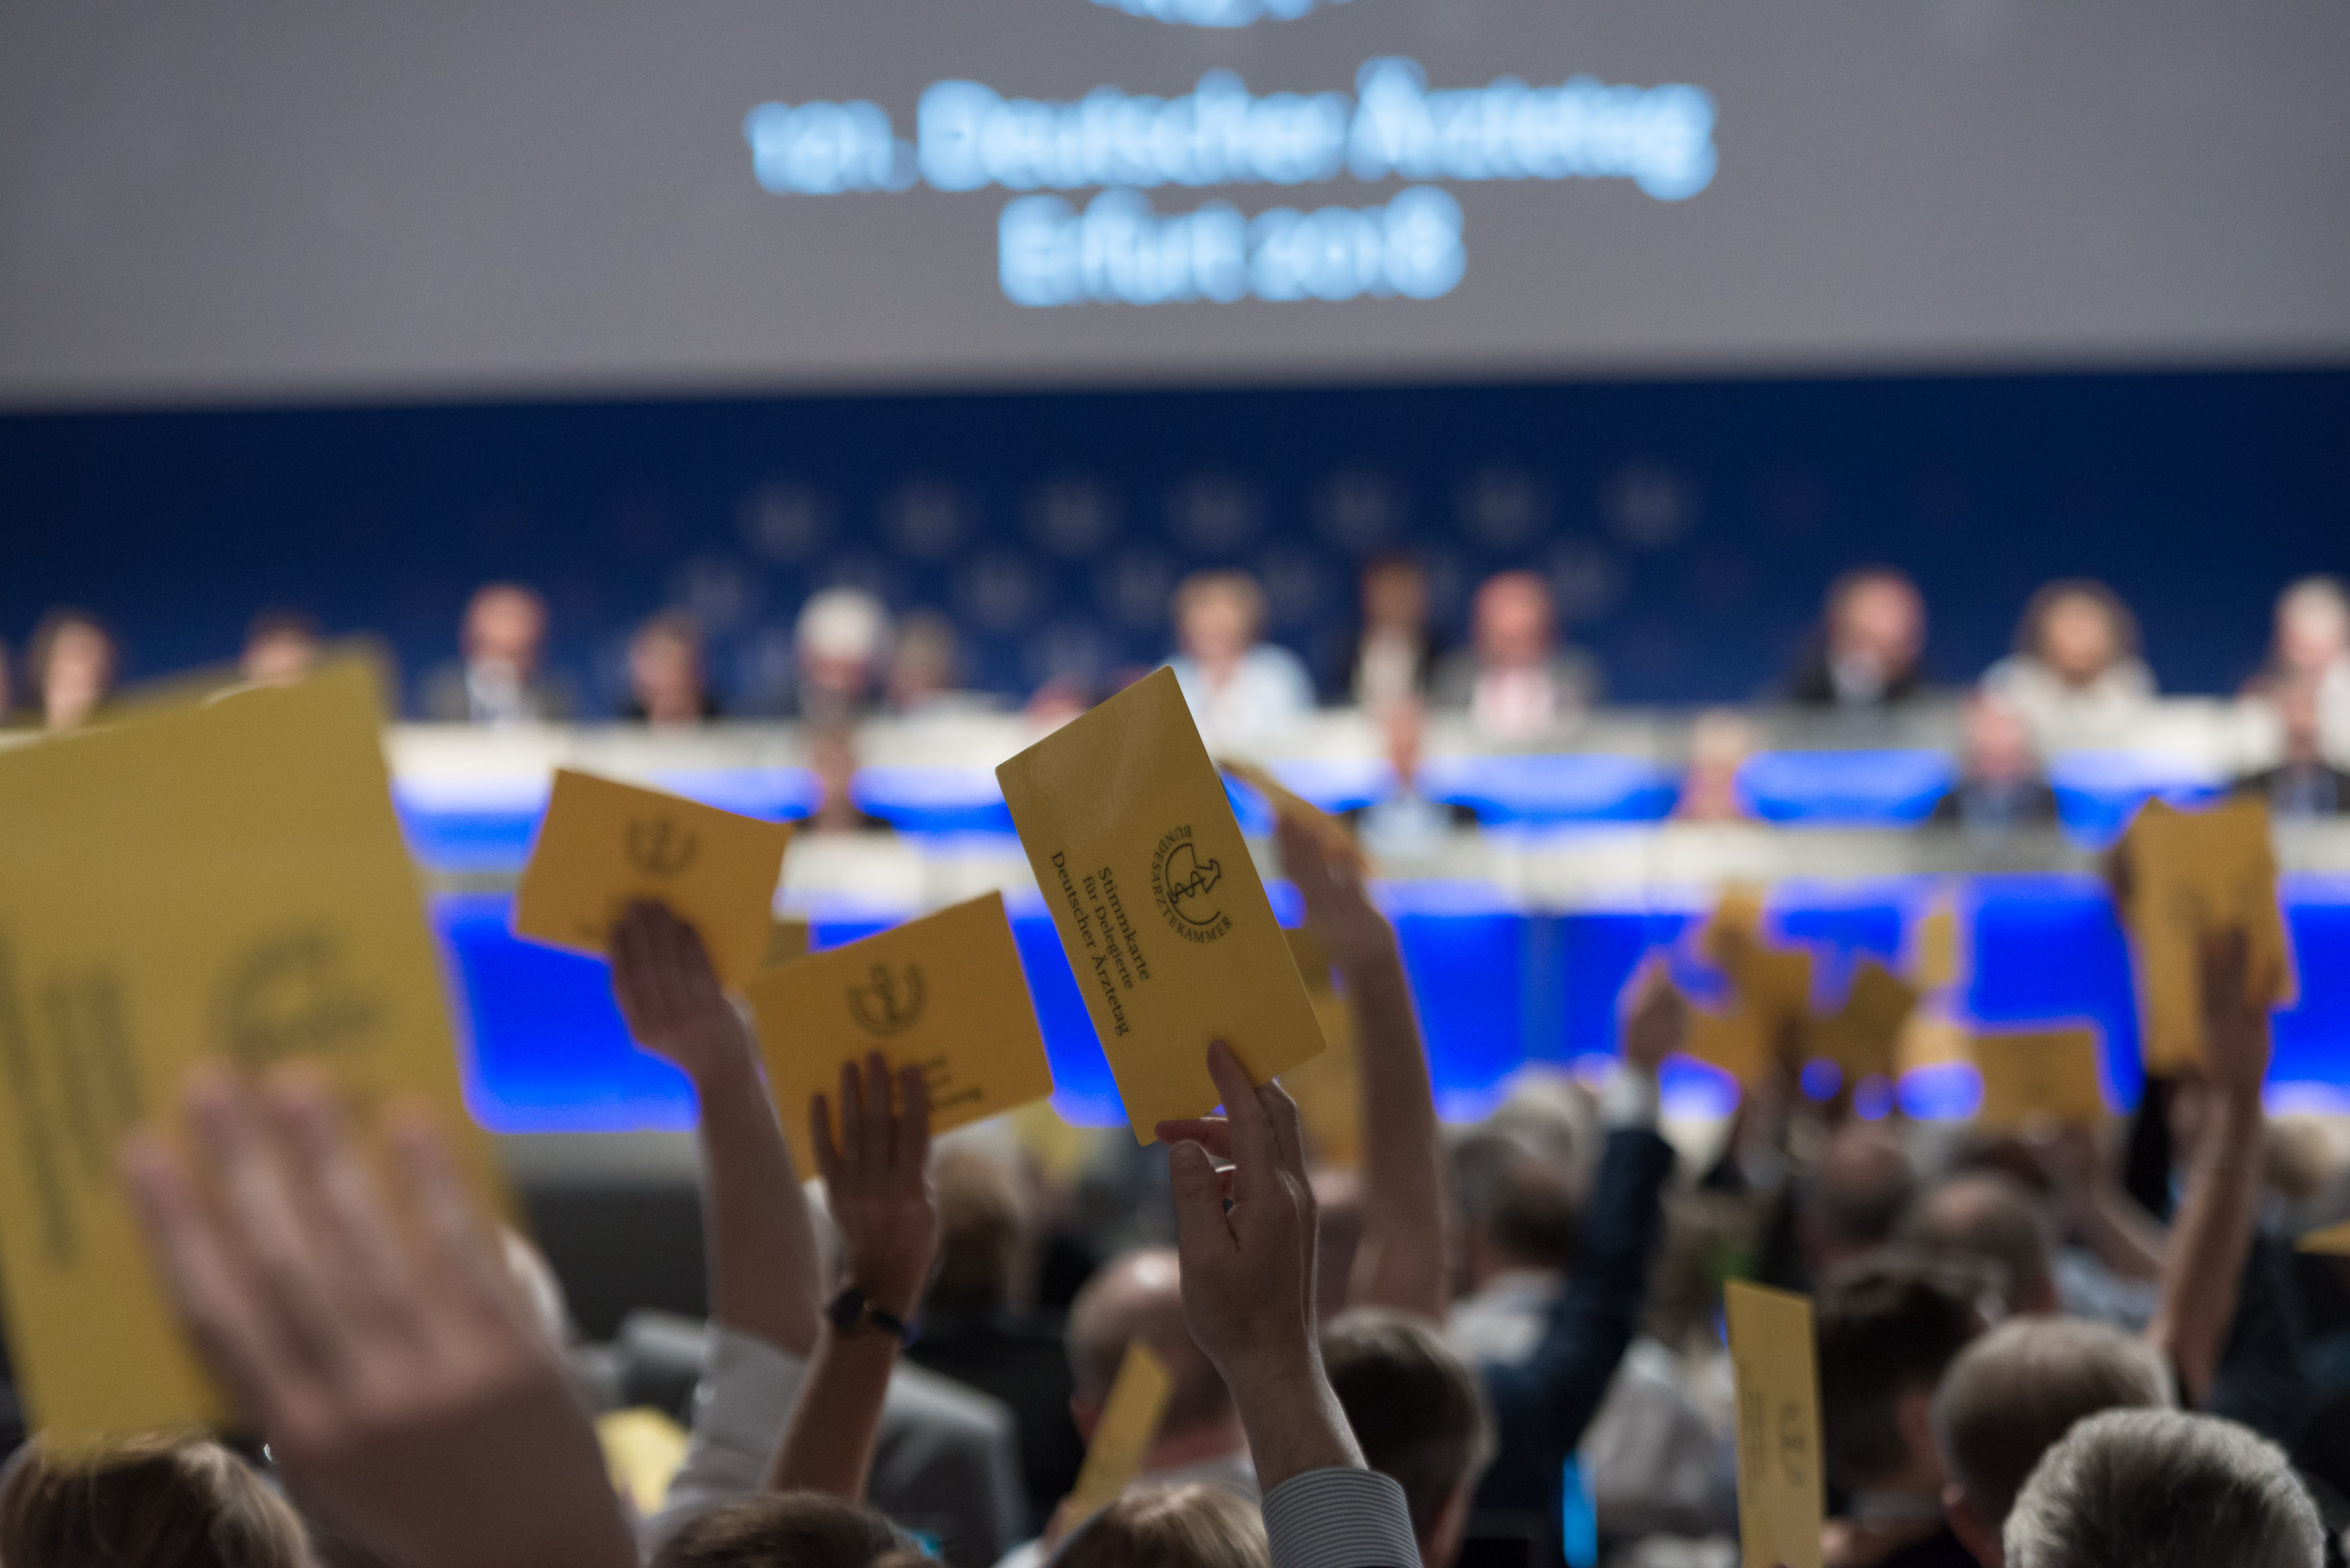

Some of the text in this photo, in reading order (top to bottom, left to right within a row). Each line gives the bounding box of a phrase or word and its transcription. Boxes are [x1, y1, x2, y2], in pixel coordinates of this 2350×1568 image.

[919, 71, 1342, 189] Deutscher
[999, 189, 1248, 306] Erfurt
[1051, 850, 1130, 1037] Deutscher Ärztetag
[1082, 876, 1133, 990] für Delegierte
[1098, 866, 1149, 981] Stimmkarte
